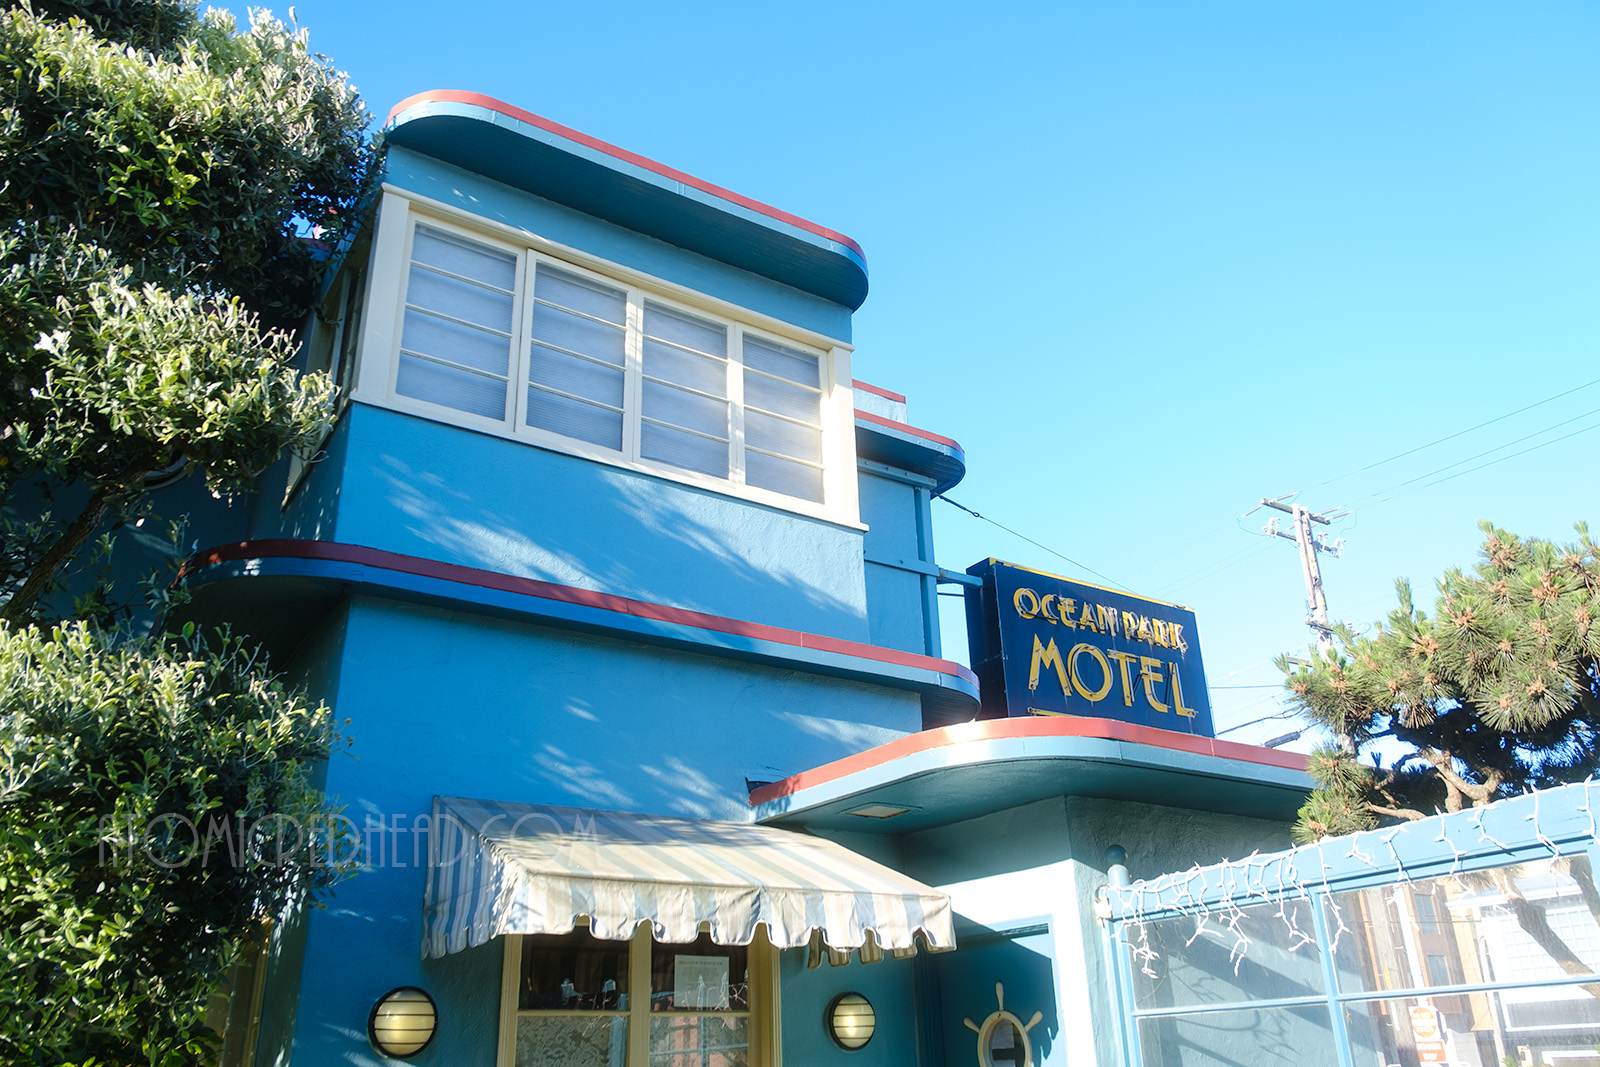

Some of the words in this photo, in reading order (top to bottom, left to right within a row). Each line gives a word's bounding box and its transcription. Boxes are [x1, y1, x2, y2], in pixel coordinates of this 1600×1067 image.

[1013, 587, 1119, 637] OCEAN
[1121, 611, 1189, 653] PARK
[1028, 633, 1199, 718] MOTEL
